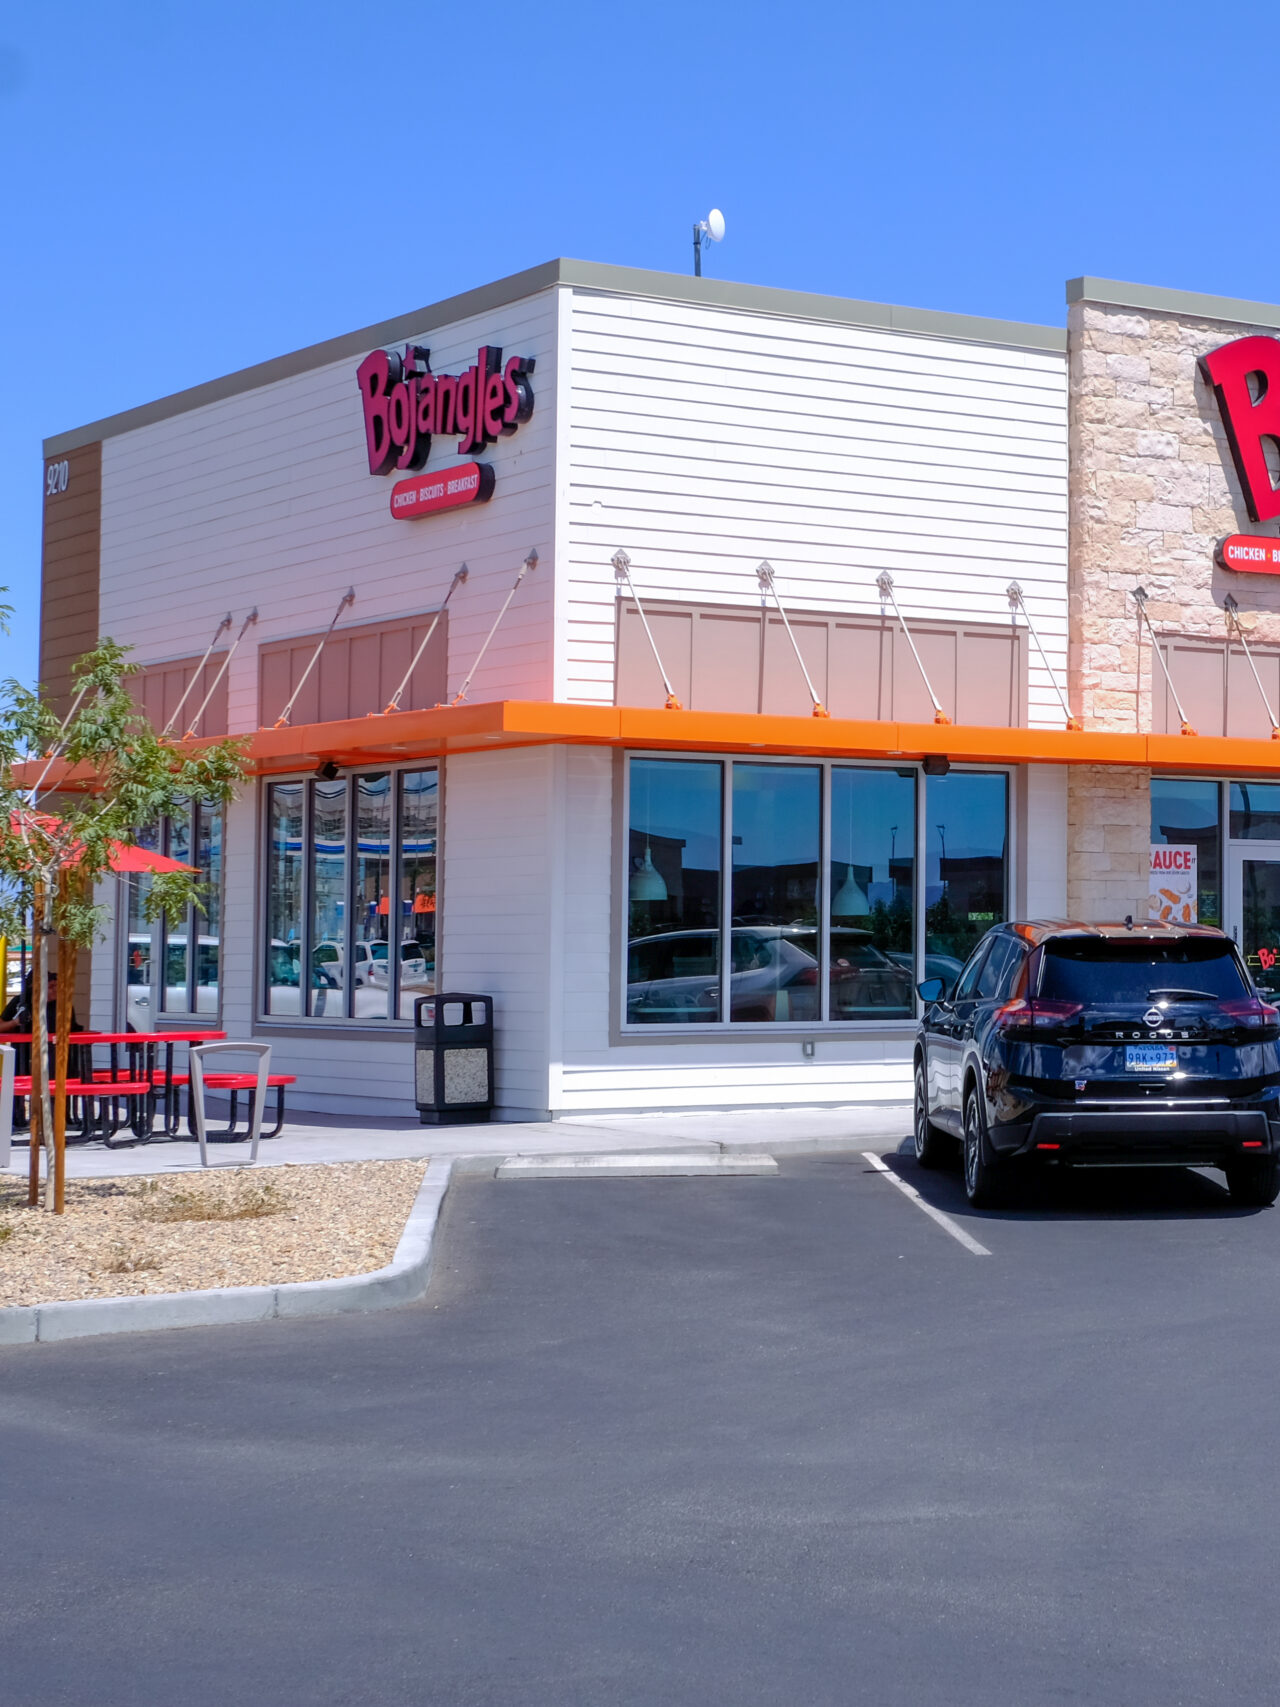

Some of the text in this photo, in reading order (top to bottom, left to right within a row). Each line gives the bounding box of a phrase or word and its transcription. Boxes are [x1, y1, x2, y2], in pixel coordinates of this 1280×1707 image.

[356, 344, 530, 476] Bojangles
[47, 460, 69, 496] 9210
[394, 474, 478, 508] CHICKEN BISCUITS BREAKFAST
[1228, 545, 1266, 561] CHICKEN
[1149, 850, 1191, 869] AUCE
[1258, 948, 1275, 970] Bo
